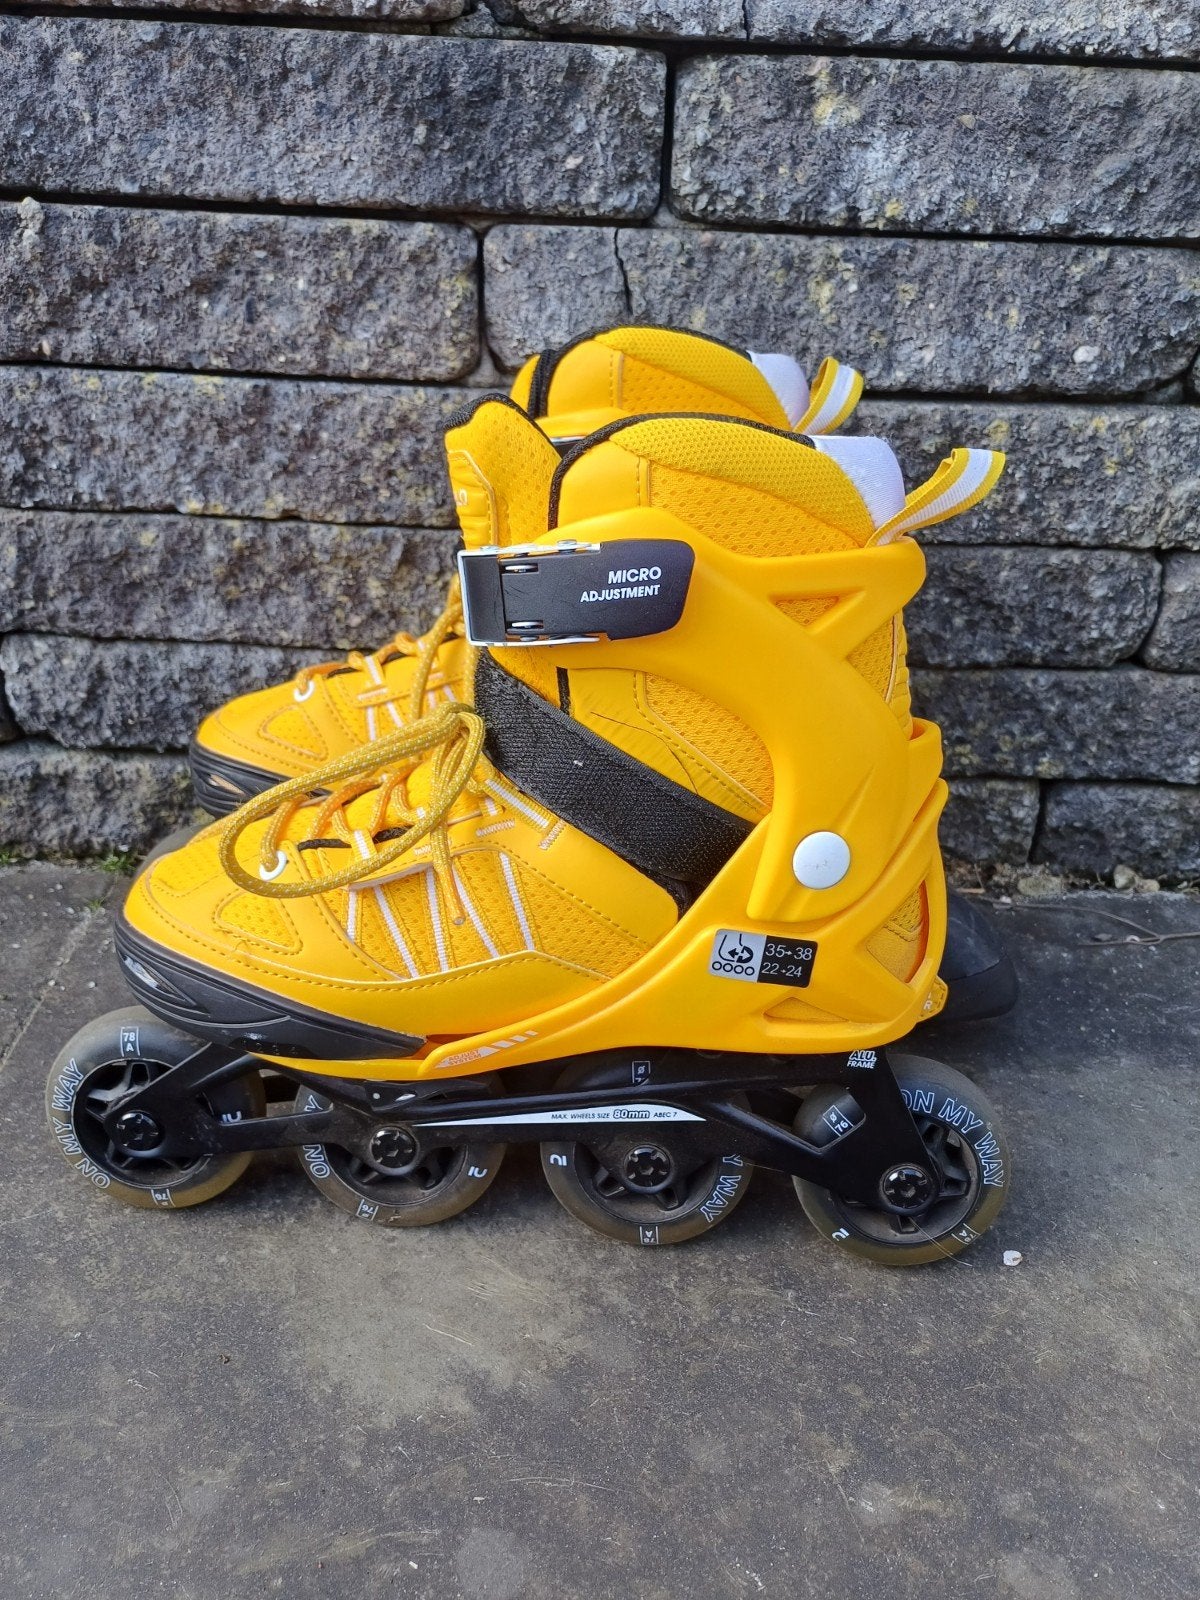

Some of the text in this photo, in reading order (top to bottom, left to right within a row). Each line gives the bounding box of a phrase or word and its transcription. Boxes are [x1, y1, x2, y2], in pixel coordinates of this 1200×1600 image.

[608, 566, 662, 584] MICRO
[580, 584, 661, 603] ADJUSTMENT
[765, 943, 813, 960] 35 38
[761, 962, 802, 977] 22 24
[123, 1032, 136, 1042] 78
[126, 1042, 135, 1052] A
[847, 1060, 876, 1069] FRAME
[613, 1108, 650, 1119] 80mm
[52, 1058, 111, 1189] ON MY WAY
[834, 1120, 849, 1132] 76
[938, 1097, 983, 1134] MY
[974, 1131, 1006, 1187] WAY
[303, 1144, 330, 1178] ON
[700, 1175, 742, 1223] WAY
